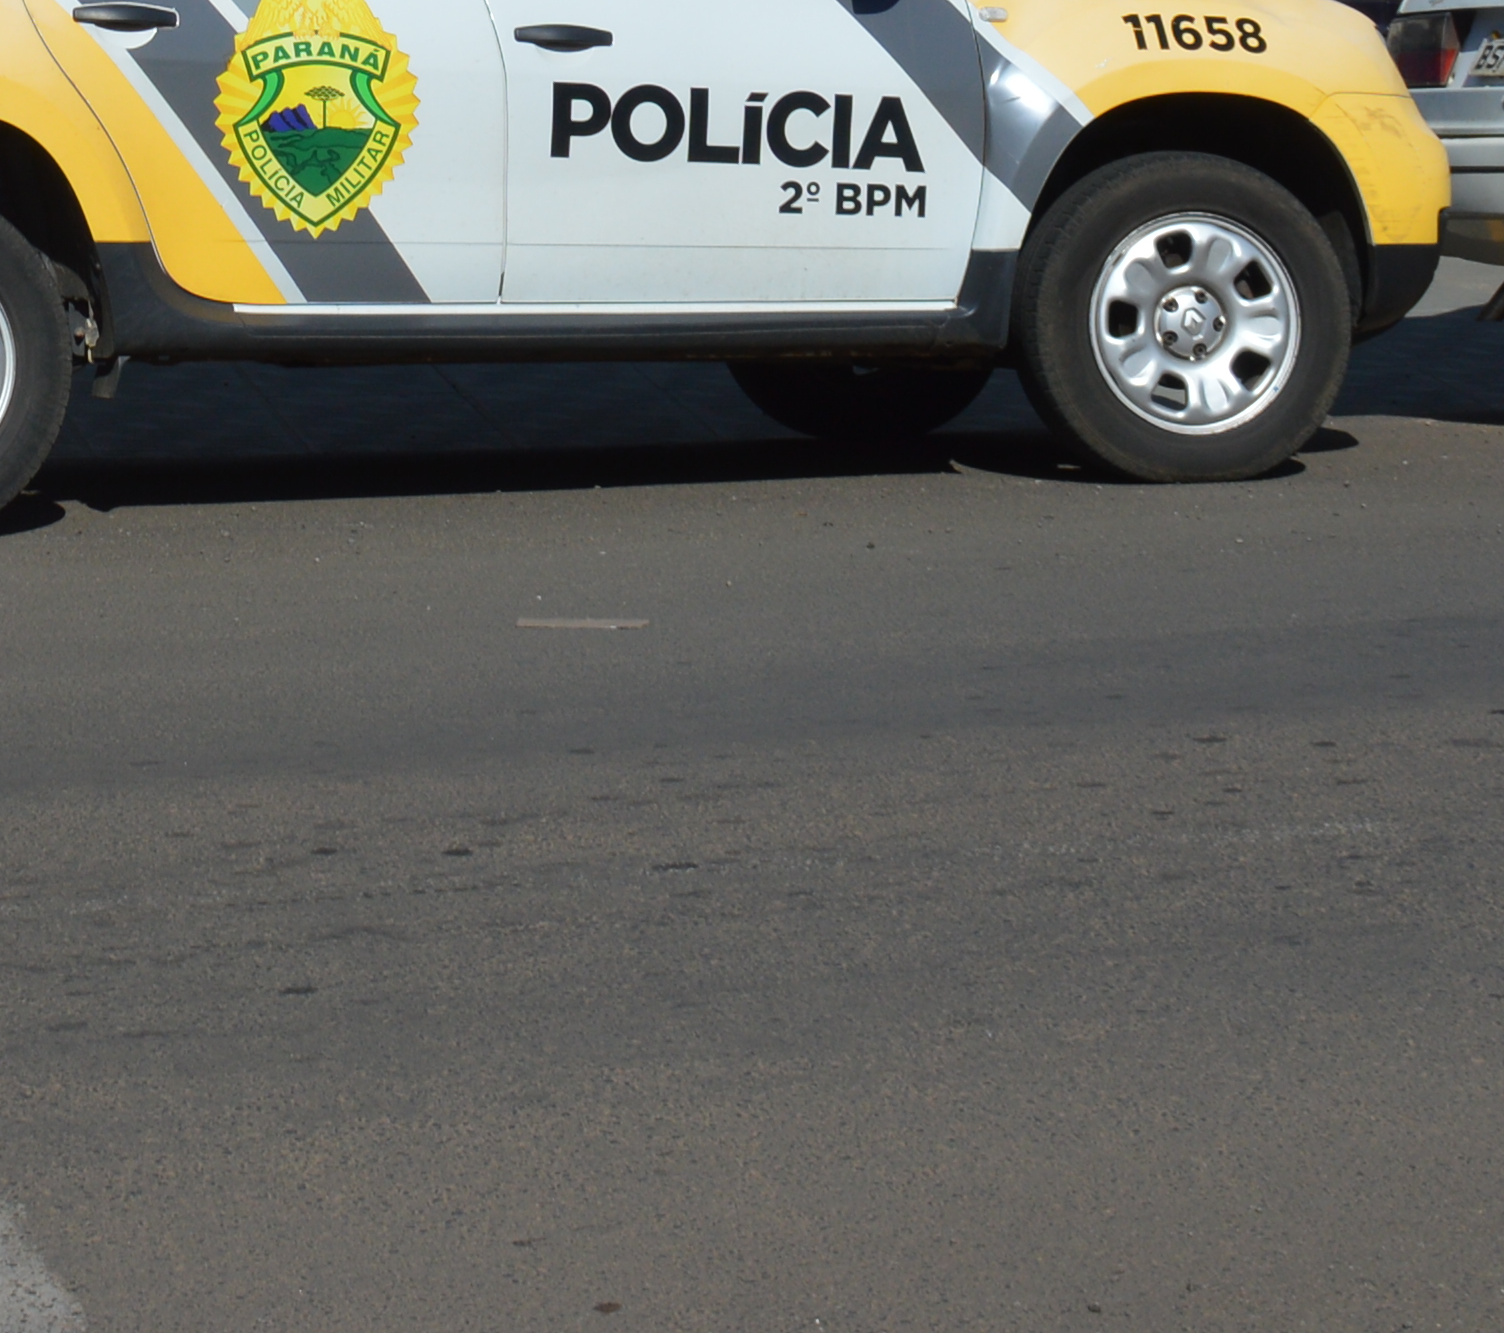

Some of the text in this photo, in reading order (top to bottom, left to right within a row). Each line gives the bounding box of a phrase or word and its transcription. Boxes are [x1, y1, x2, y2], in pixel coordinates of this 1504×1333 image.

[1121, 13, 1268, 54] 11658
[250, 41, 380, 71] PARANÁ
[242, 129, 306, 208] POLÍCIA
[324, 130, 391, 208] MILITAR
[835, 182, 927, 218] BPM
